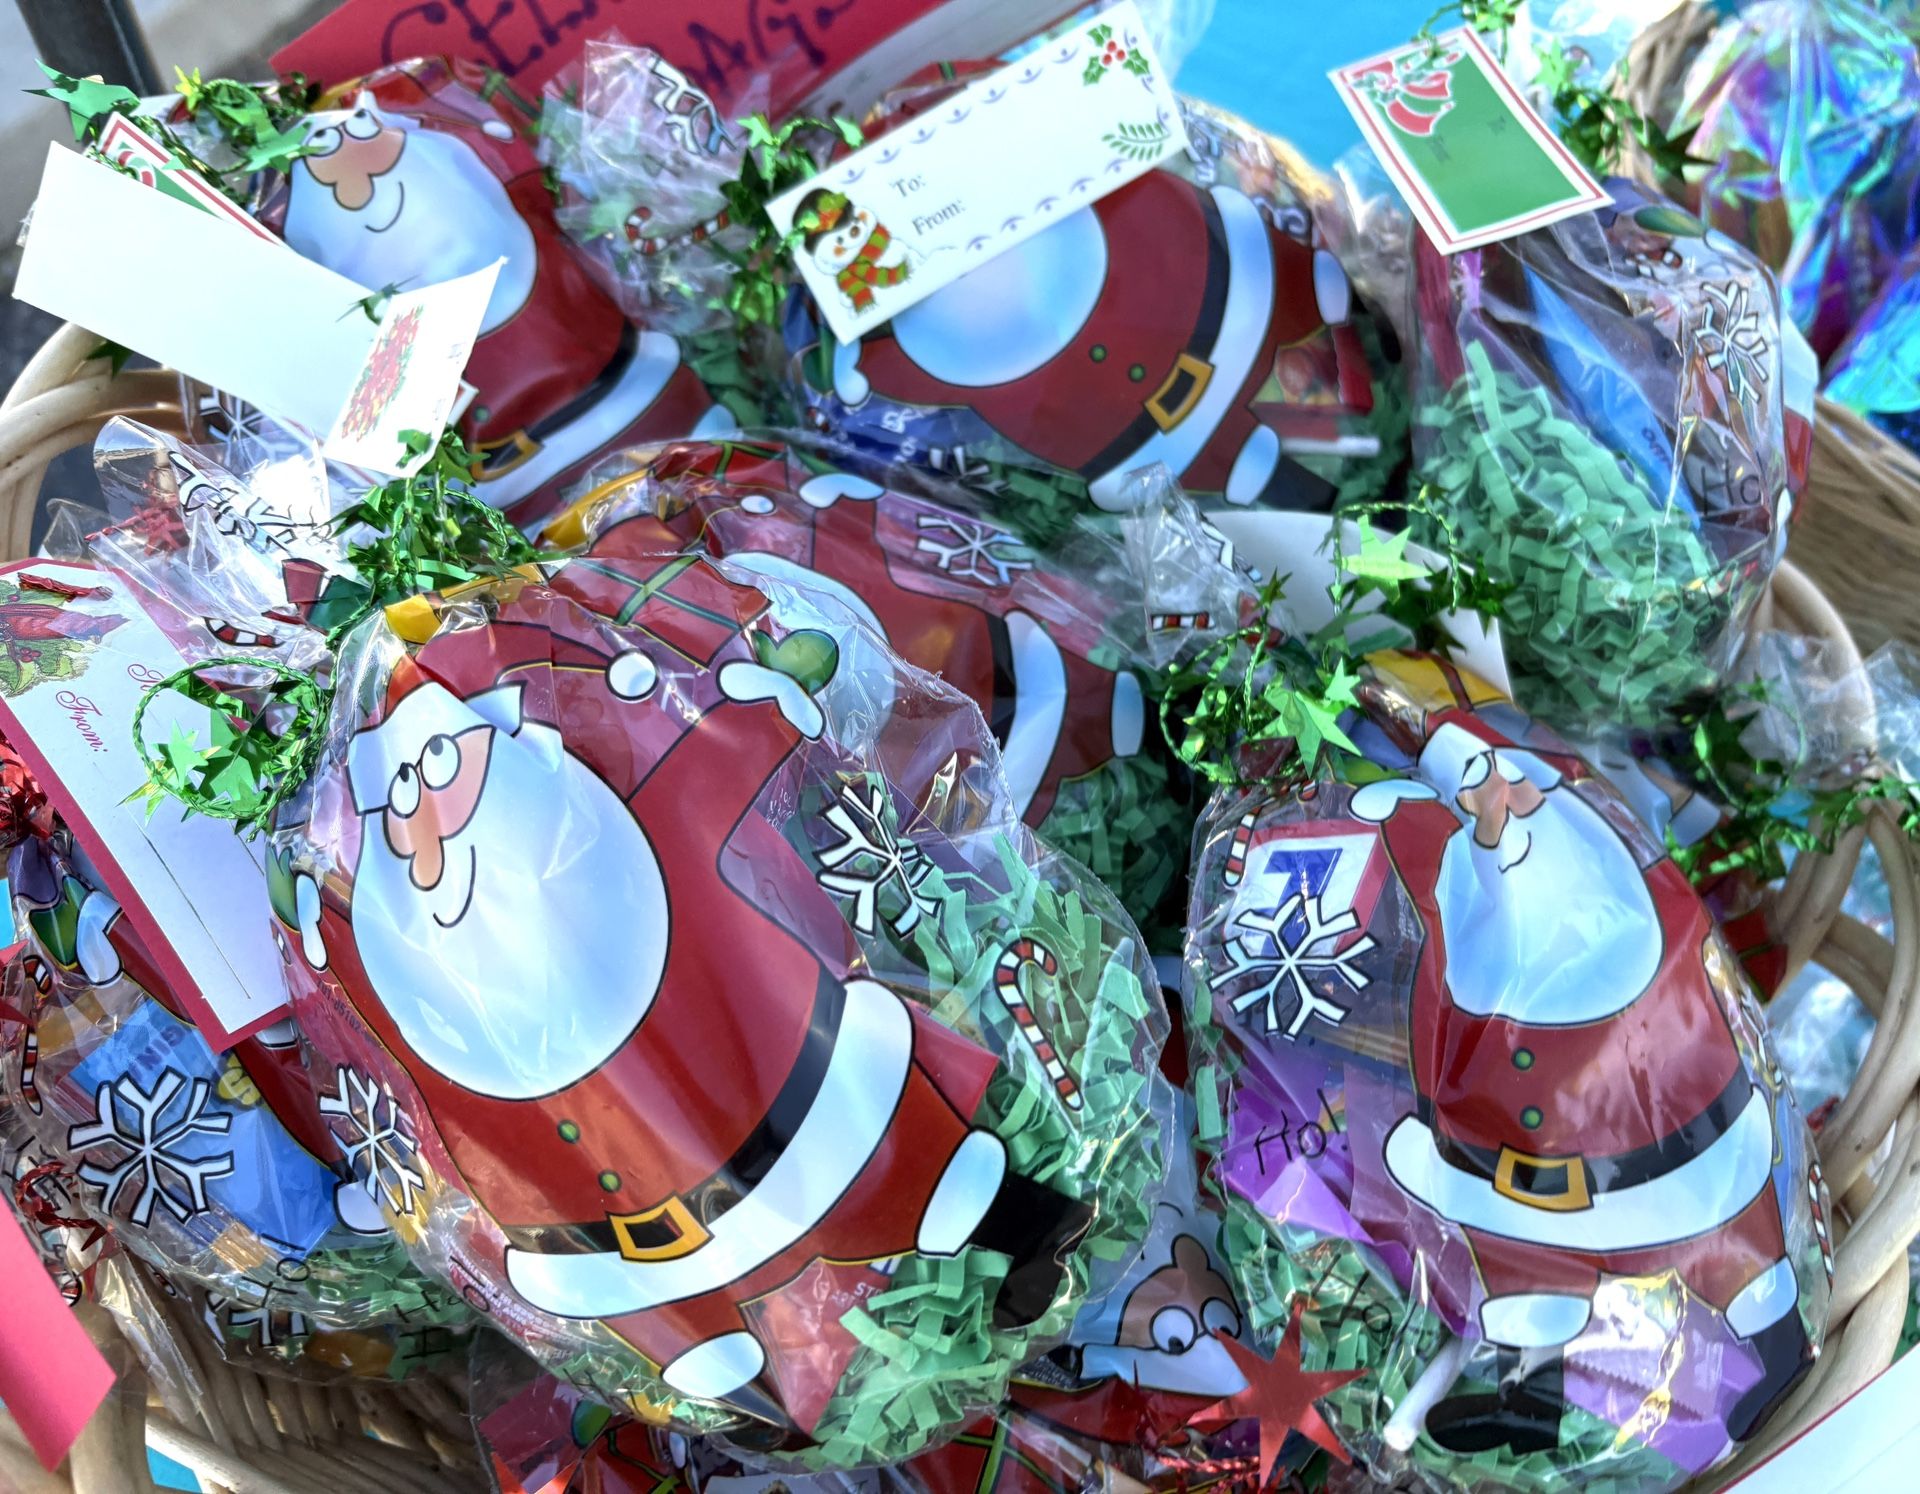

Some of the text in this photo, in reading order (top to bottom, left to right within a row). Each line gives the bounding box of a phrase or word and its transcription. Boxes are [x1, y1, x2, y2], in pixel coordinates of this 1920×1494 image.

[889, 175, 926, 197] To:
[911, 199, 966, 236] From:
[56, 690, 108, 752] From:
[1254, 1088, 1348, 1175] Ho!
